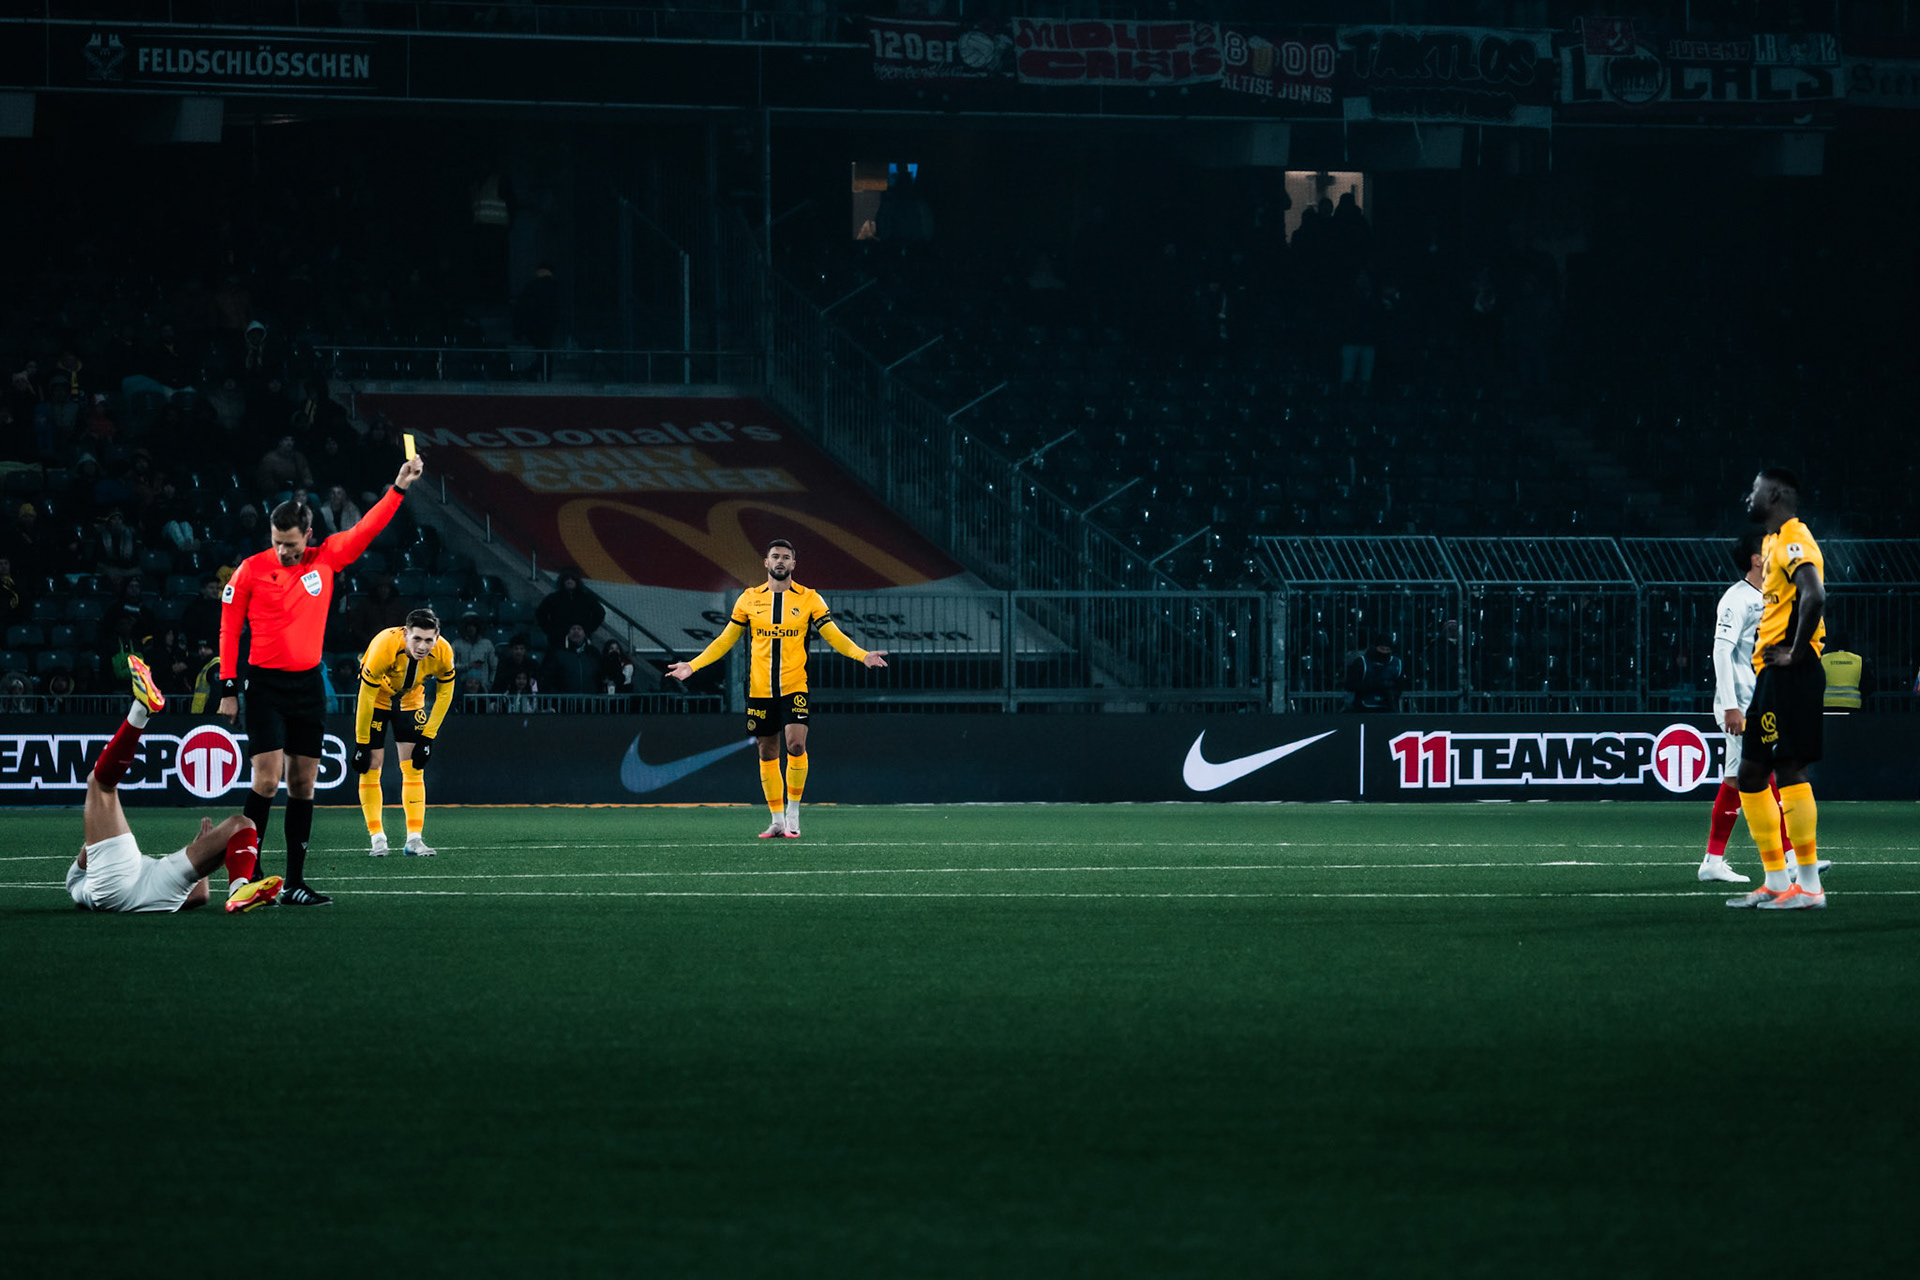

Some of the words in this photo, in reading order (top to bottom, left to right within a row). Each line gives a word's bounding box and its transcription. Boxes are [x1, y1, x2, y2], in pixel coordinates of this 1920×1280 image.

[869, 28, 958, 63] 120er
[138, 45, 370, 78] FELDSCHLÖSSCHEN
[1277, 81, 1333, 104] JUNGS
[402, 422, 783, 448] McDonald's
[475, 446, 700, 470] FAMILY
[521, 468, 792, 491] CORNER
[756, 628, 799, 638] Plus500
